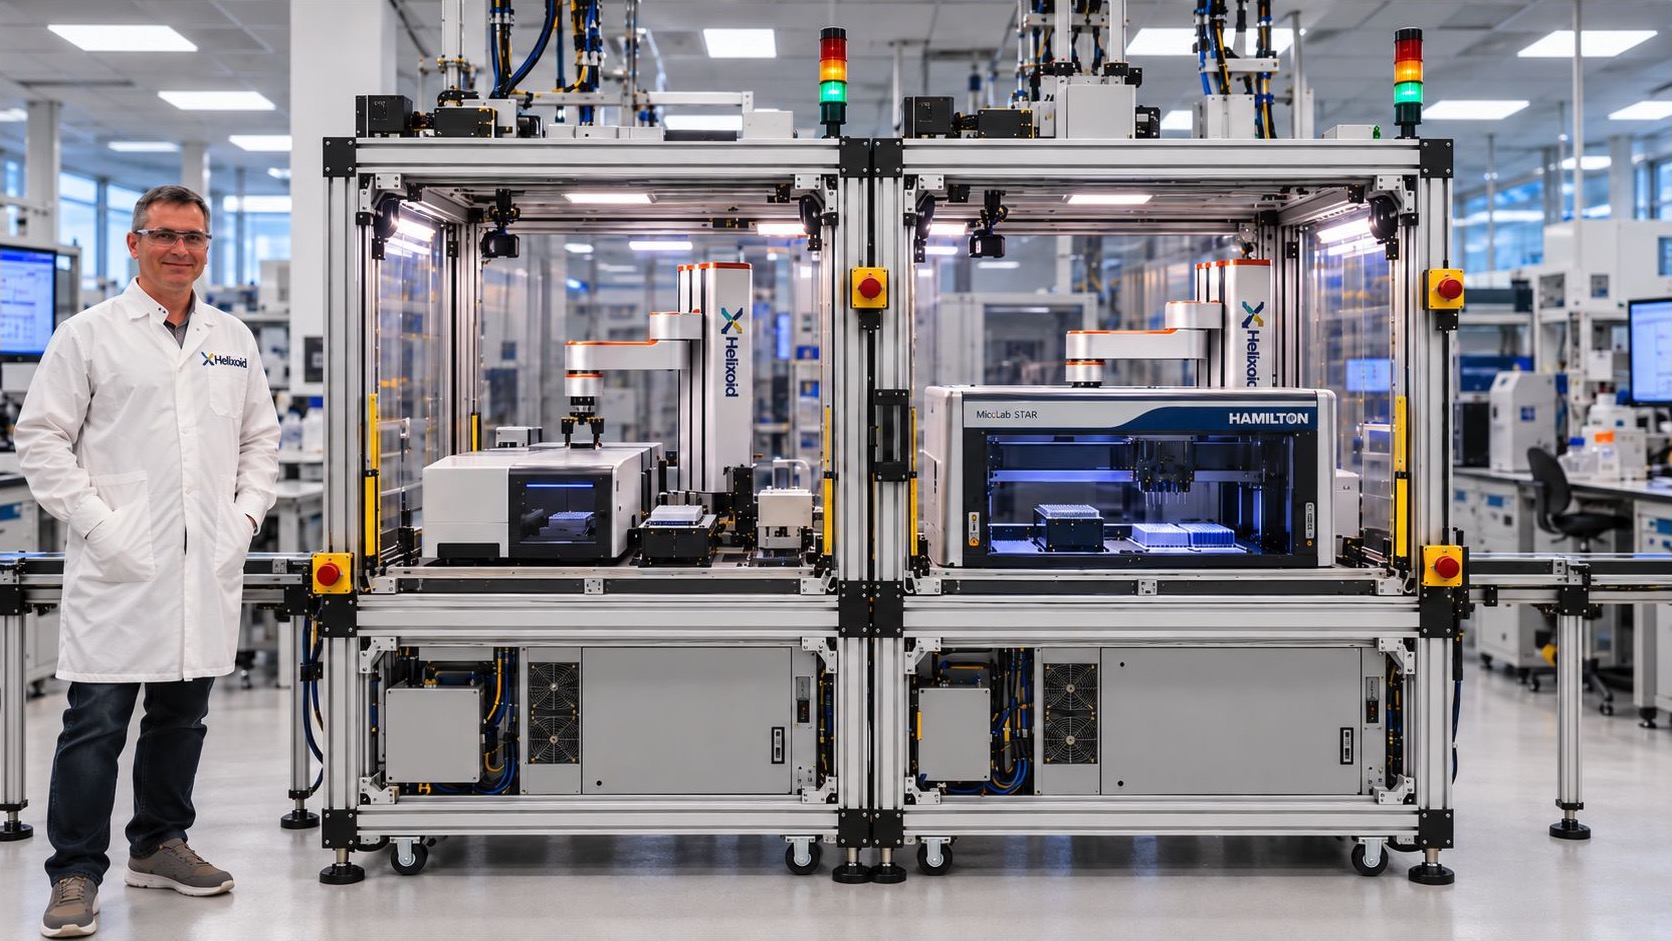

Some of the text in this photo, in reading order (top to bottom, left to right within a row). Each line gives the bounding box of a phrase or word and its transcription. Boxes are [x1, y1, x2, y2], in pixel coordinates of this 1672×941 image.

[725, 337, 739, 397] Helixoid
[1014, 410, 1038, 419] STAR
[1229, 412, 1309, 425] HAMILTON
